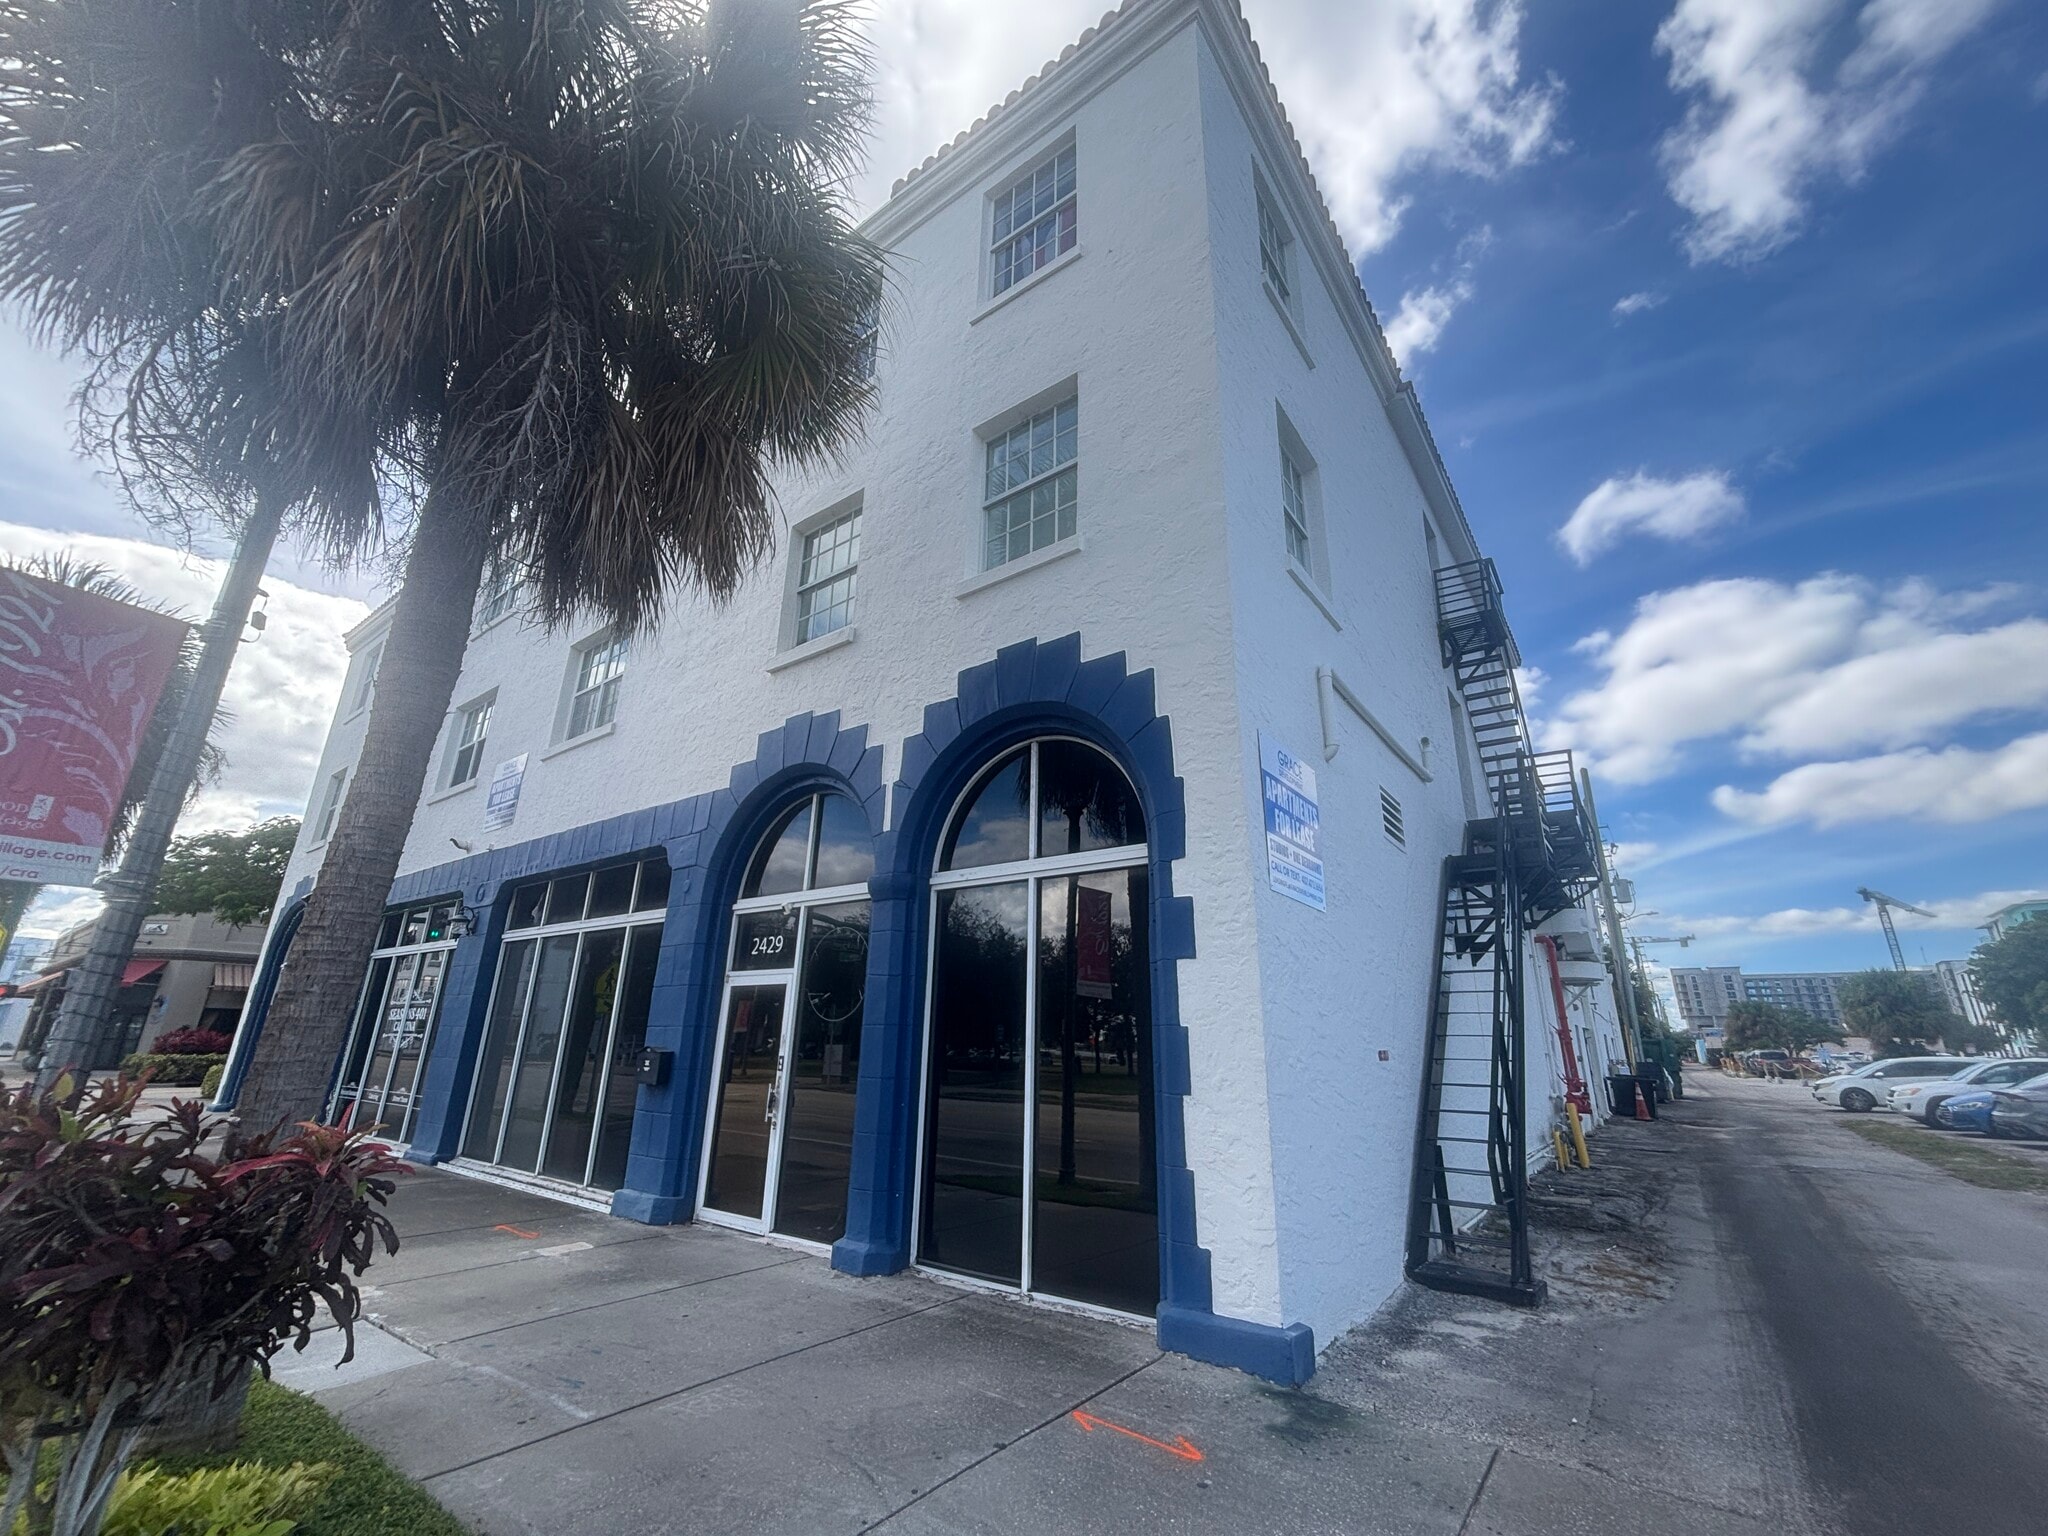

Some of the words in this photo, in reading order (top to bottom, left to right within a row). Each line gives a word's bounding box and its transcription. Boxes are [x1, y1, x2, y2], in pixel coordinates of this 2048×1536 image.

[1277, 750, 1303, 781] GRACE
[1265, 775, 1319, 830] APARTMENTS
[1274, 807, 1292, 840] FOR
[1292, 818, 1315, 853] LEASE
[1270, 860, 1283, 874] CALL
[751, 935, 784, 955] 2429
[389, 1008, 416, 1020] SEASNS
